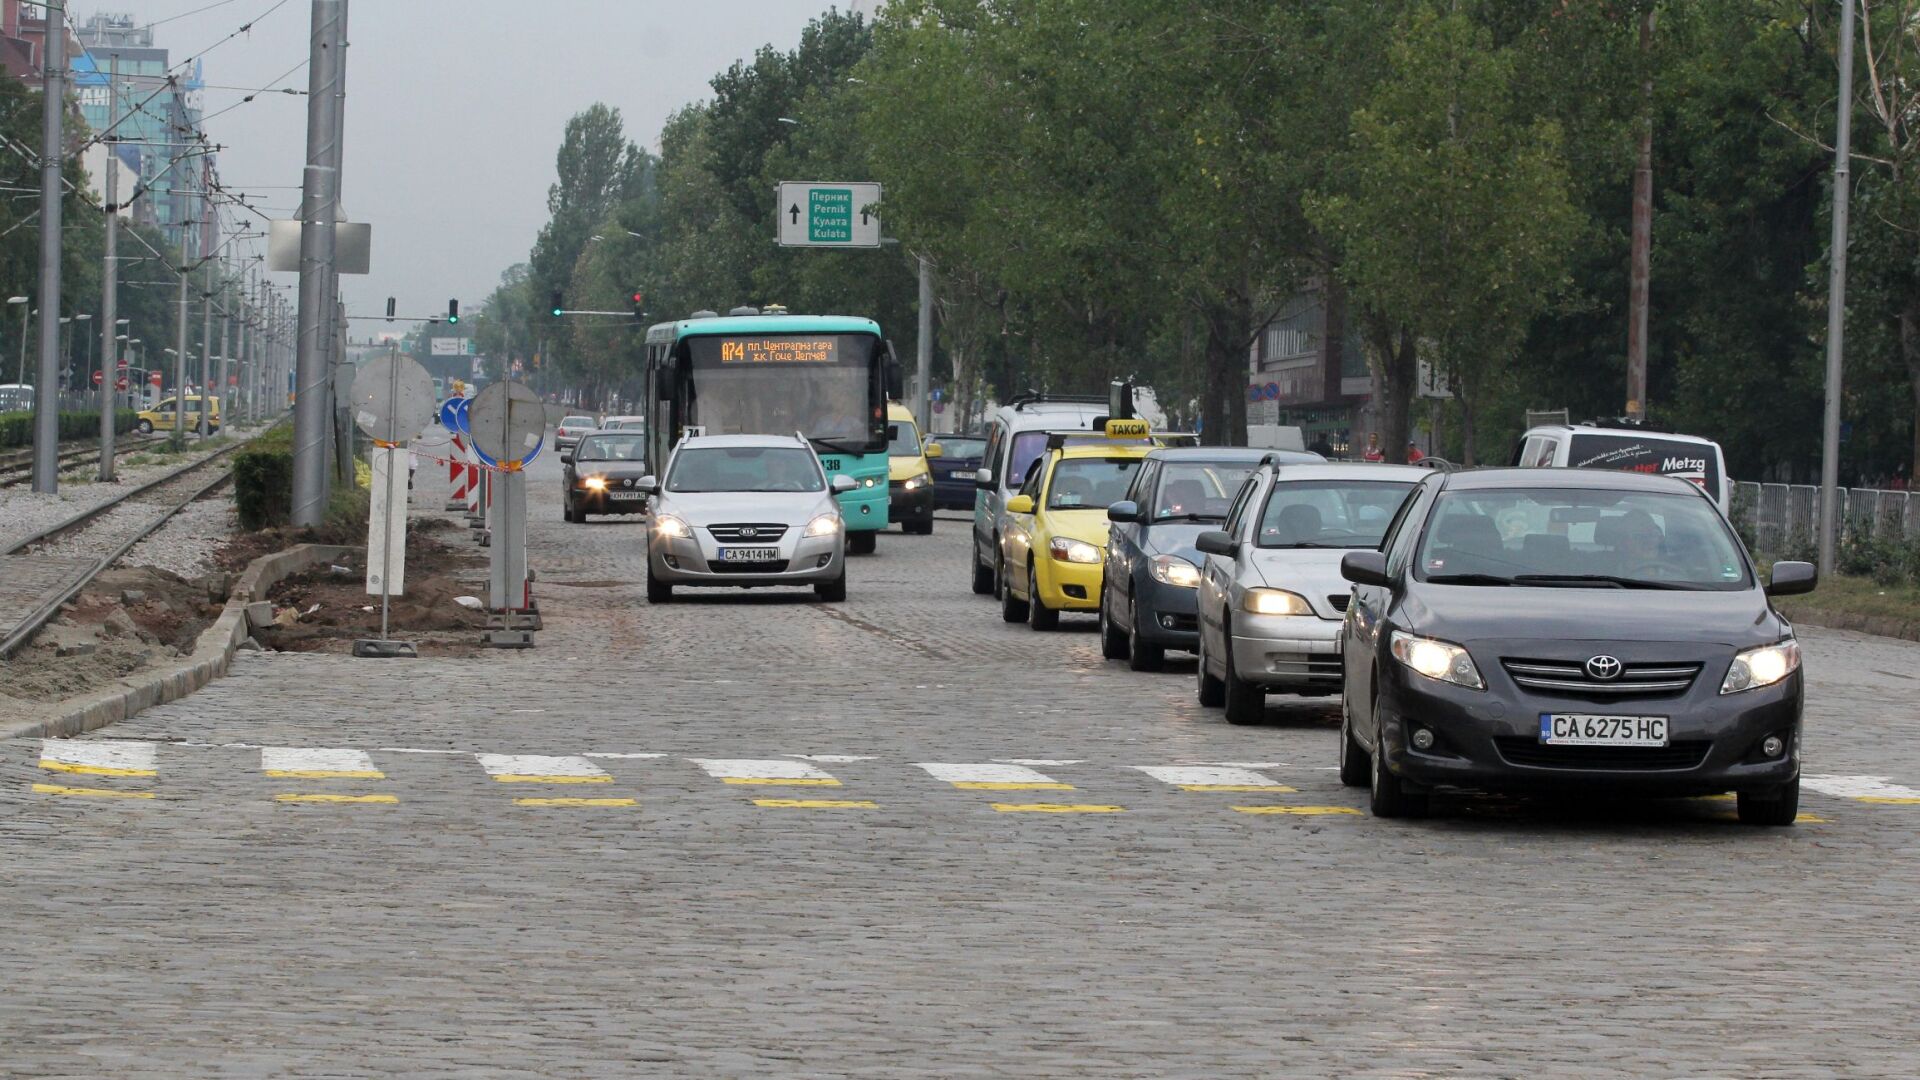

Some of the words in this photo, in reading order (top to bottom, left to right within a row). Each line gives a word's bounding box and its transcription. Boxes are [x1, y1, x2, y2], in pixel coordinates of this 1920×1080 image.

[811, 192, 849, 203] Перник
[814, 204, 847, 213] Pernik
[813, 217, 847, 227] Кулата
[814, 229, 847, 238] Kulata
[770, 351, 792, 361] Гоце
[1111, 424, 1146, 435] ТАКСИ
[1662, 456, 1705, 472] Metzg
[741, 528, 756, 536] KIA
[725, 550, 738, 560] CA
[739, 550, 762, 560] 9414
[763, 549, 777, 559] HM
[1554, 718, 1580, 738] CA
[1584, 719, 1633, 739] 6275
[1637, 719, 1664, 739] HC
